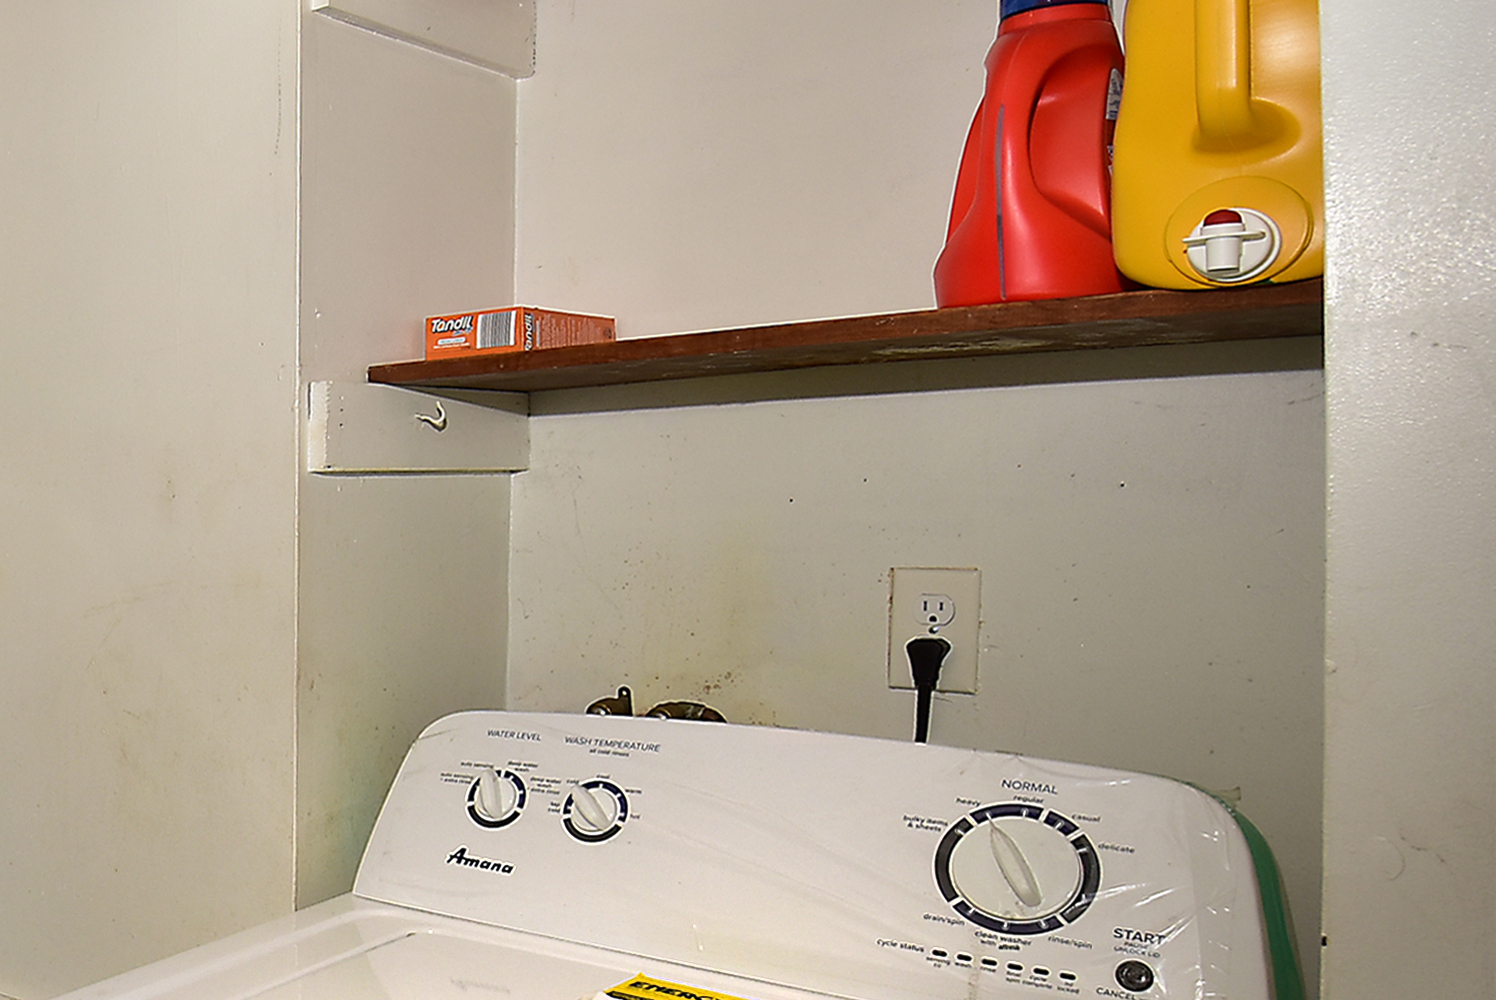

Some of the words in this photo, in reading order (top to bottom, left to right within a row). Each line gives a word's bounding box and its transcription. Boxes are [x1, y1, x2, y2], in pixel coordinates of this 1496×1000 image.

[431, 315, 474, 334] Tandil
[487, 730, 515, 738] WATER
[516, 732, 542, 741] LEVEL
[565, 737, 592, 746] WASH
[594, 739, 661, 752] TEMPERATURE
[1001, 779, 1058, 795] NORMAL
[956, 797, 982, 807] heavy
[1013, 794, 1044, 804] regular
[1071, 814, 1101, 822] casual
[916, 823, 942, 832] sheets
[1098, 842, 1135, 853] delicate
[446, 847, 514, 874] Amana
[923, 913, 965, 926] drain/spin
[974, 930, 999, 940] clean
[1000, 934, 1032, 946] washer
[1047, 936, 1093, 949] rinse/spin
[1113, 928, 1166, 945] START
[876, 939, 898, 948] cycle
[899, 942, 925, 953] status
[1096, 987, 1137, 1000] CANCEL
